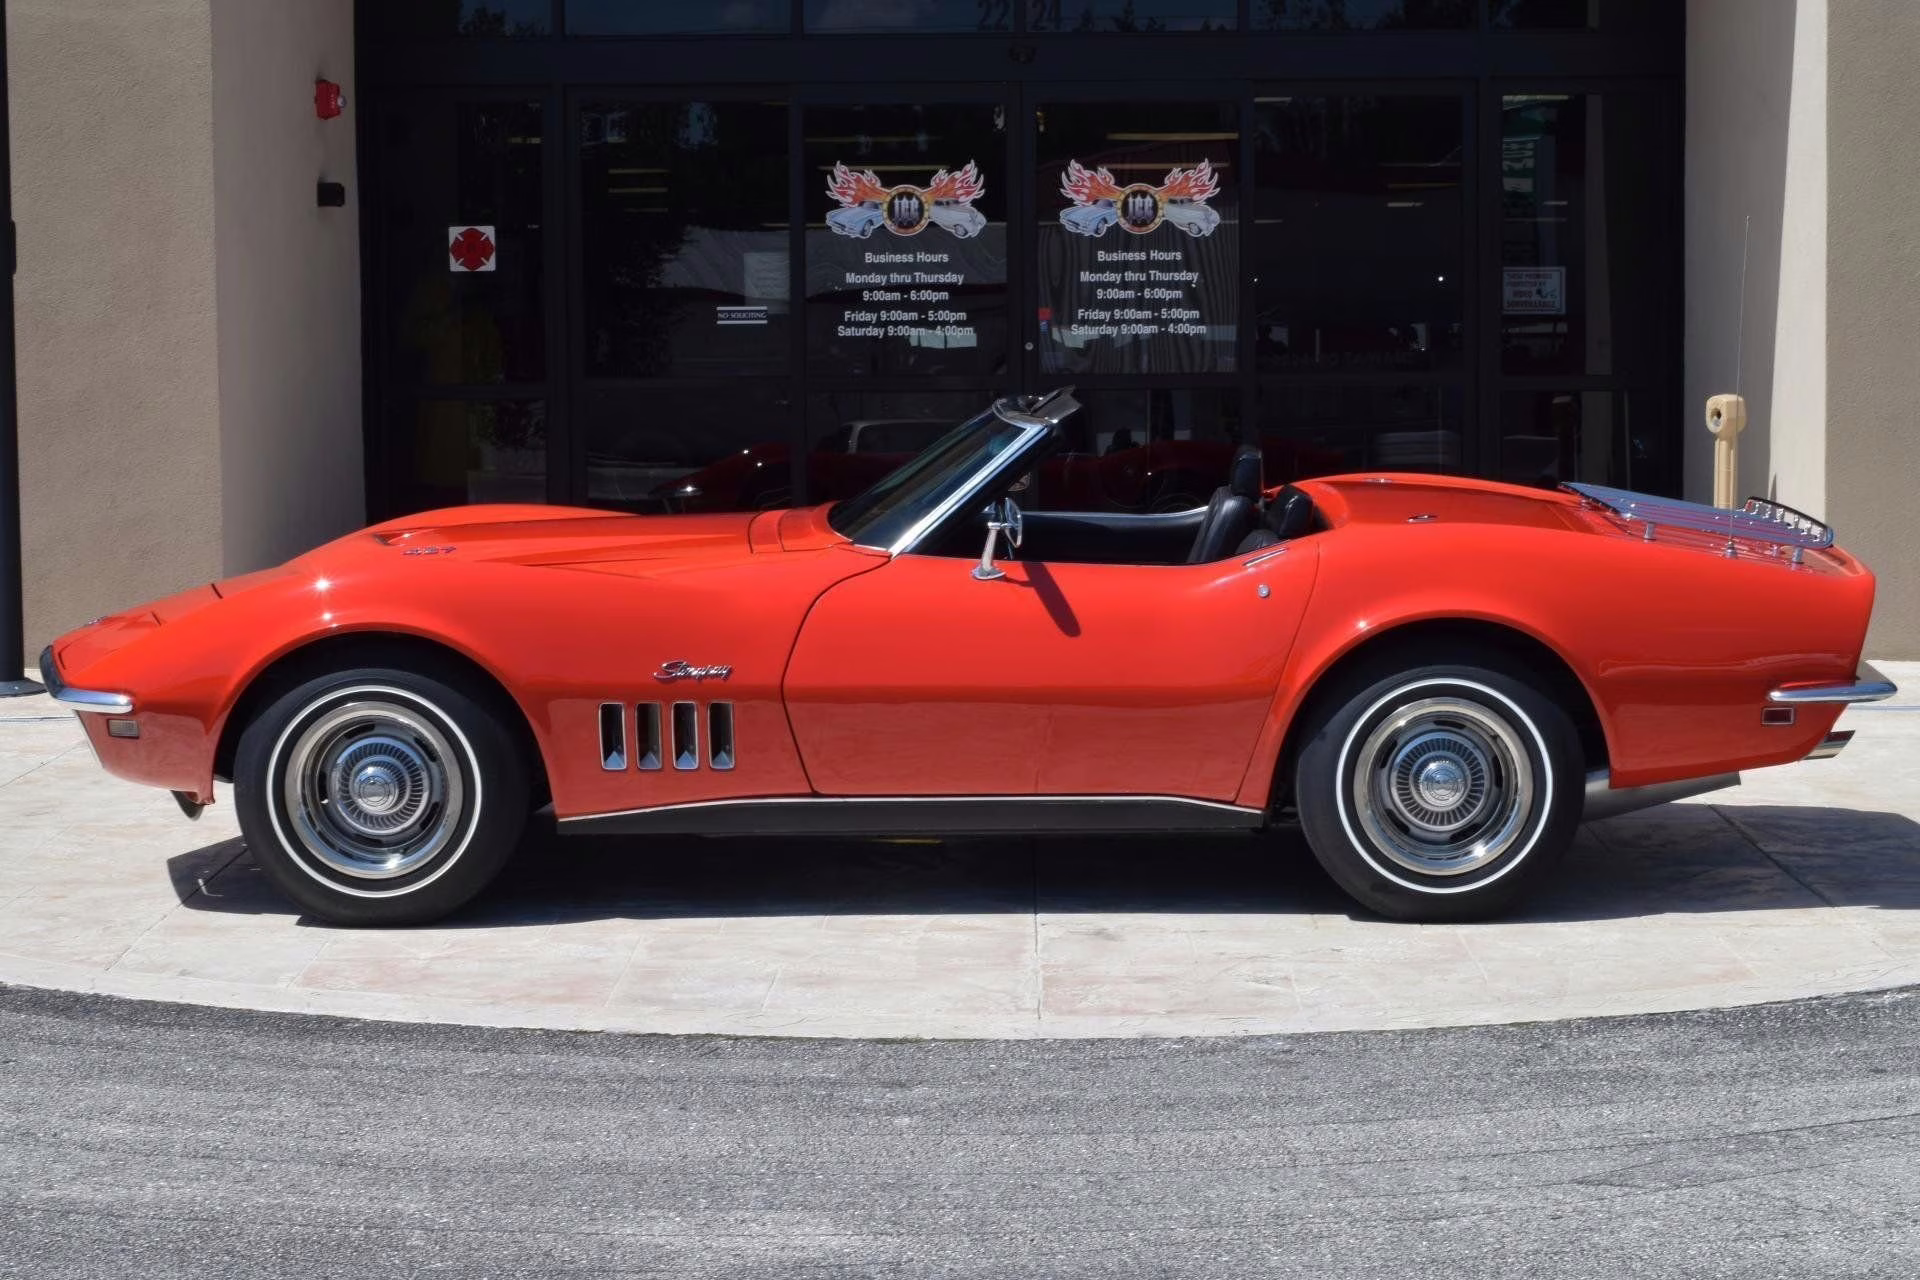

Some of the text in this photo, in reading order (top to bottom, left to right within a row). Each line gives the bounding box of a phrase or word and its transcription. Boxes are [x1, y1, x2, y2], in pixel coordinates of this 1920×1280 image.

[865, 252, 949, 263] Business Hours
[1097, 250, 1182, 262] Business Hours
[845, 272, 964, 285] Monday thru Thursday
[1080, 270, 1199, 284] Monday thru Thursday
[862, 290, 901, 301] 9:00am
[910, 290, 949, 303] 6:00pm
[1096, 288, 1135, 299] 9:00am
[1144, 288, 1183, 301] 6:00pm
[844, 311, 878, 323] Friday
[880, 311, 918, 321] 9:00am
[927, 310, 967, 323] 5:00pm
[1078, 309, 1111, 321] Friday
[1113, 309, 1152, 319] 9:00am
[1161, 308, 1200, 321] 5:00pm
[837, 325, 885, 339] Saturday
[887, 326, 926, 336] 9:00am
[935, 325, 974, 338] 4:00pm
[1070, 324, 1119, 337] Saturday
[1121, 324, 1159, 335] 9:00am
[1167, 323, 1207, 336] 4:00pm
[653, 660, 732, 681] Stingray
